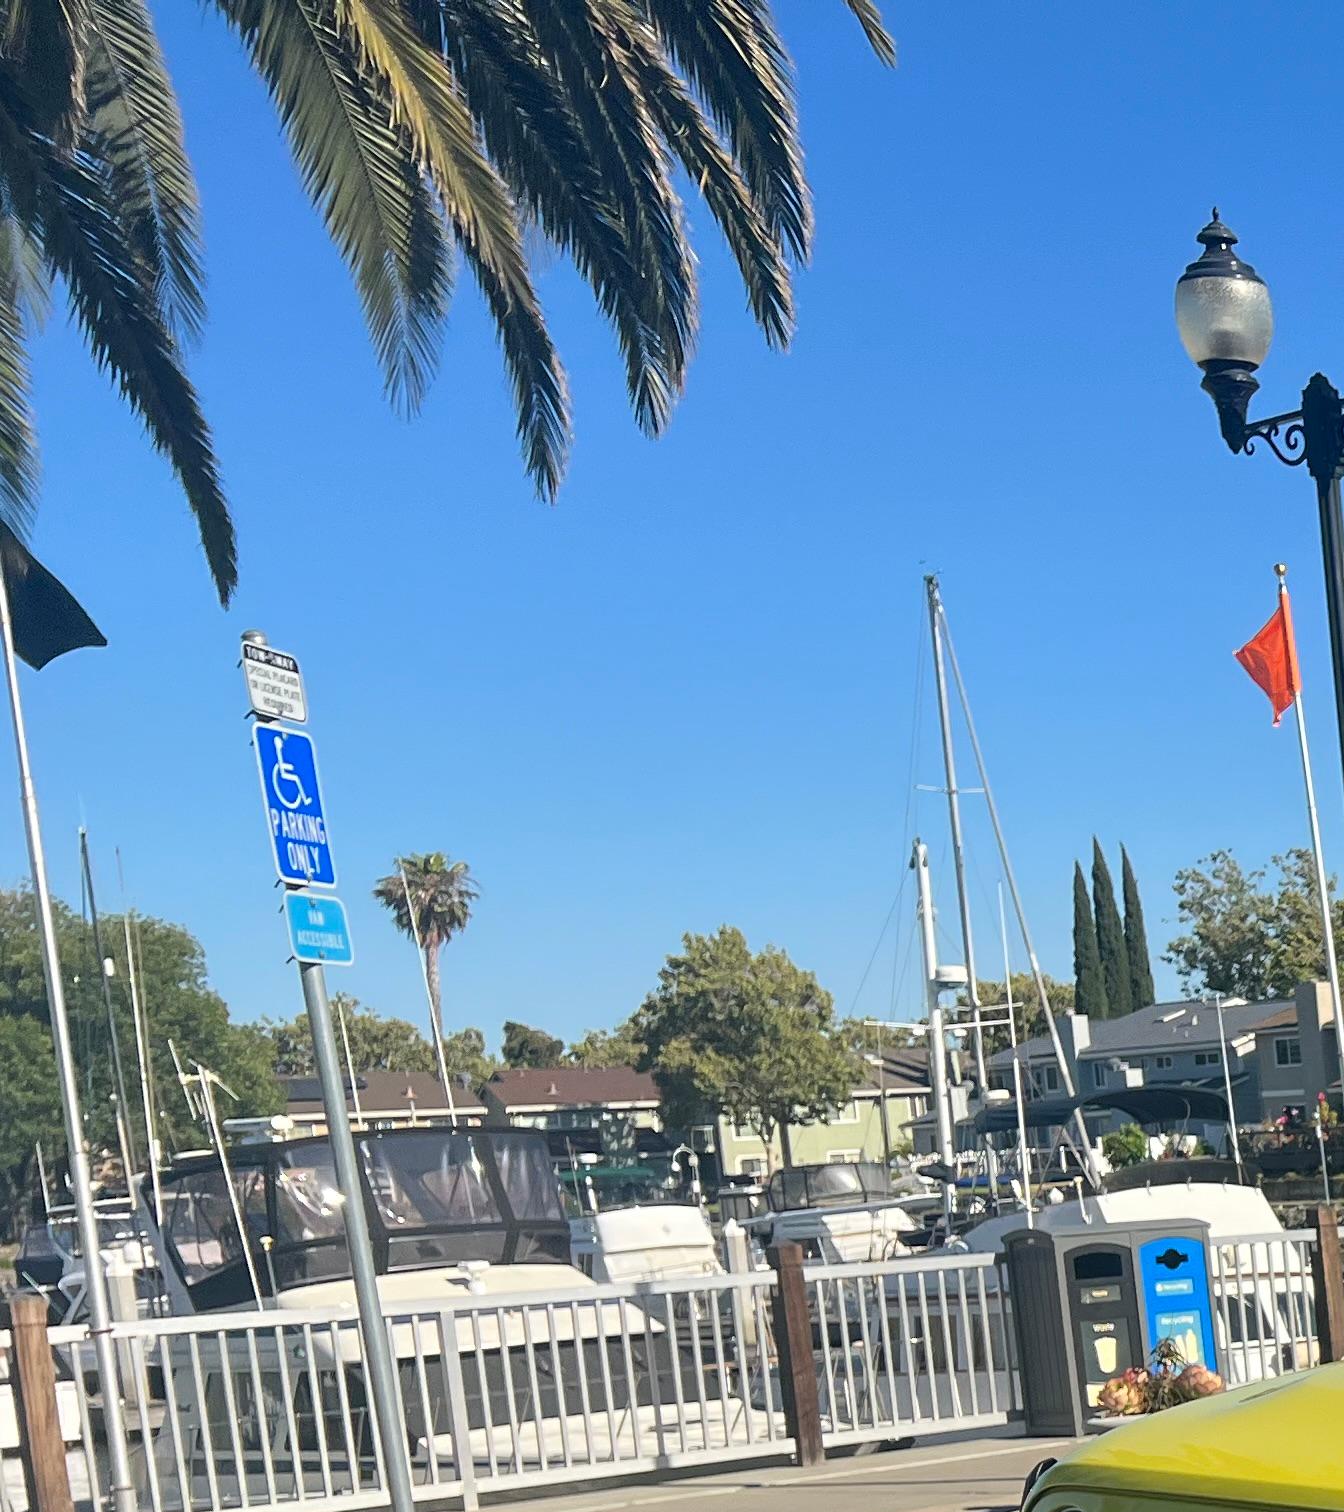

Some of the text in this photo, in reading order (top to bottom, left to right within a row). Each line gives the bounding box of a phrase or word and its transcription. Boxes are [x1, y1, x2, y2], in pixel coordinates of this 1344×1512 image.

[270, 808, 326, 845] PARKING
[287, 842, 321, 874] ONLY
[307, 909, 325, 926] VAN
[297, 930, 345, 950] ACCESSIBLE
